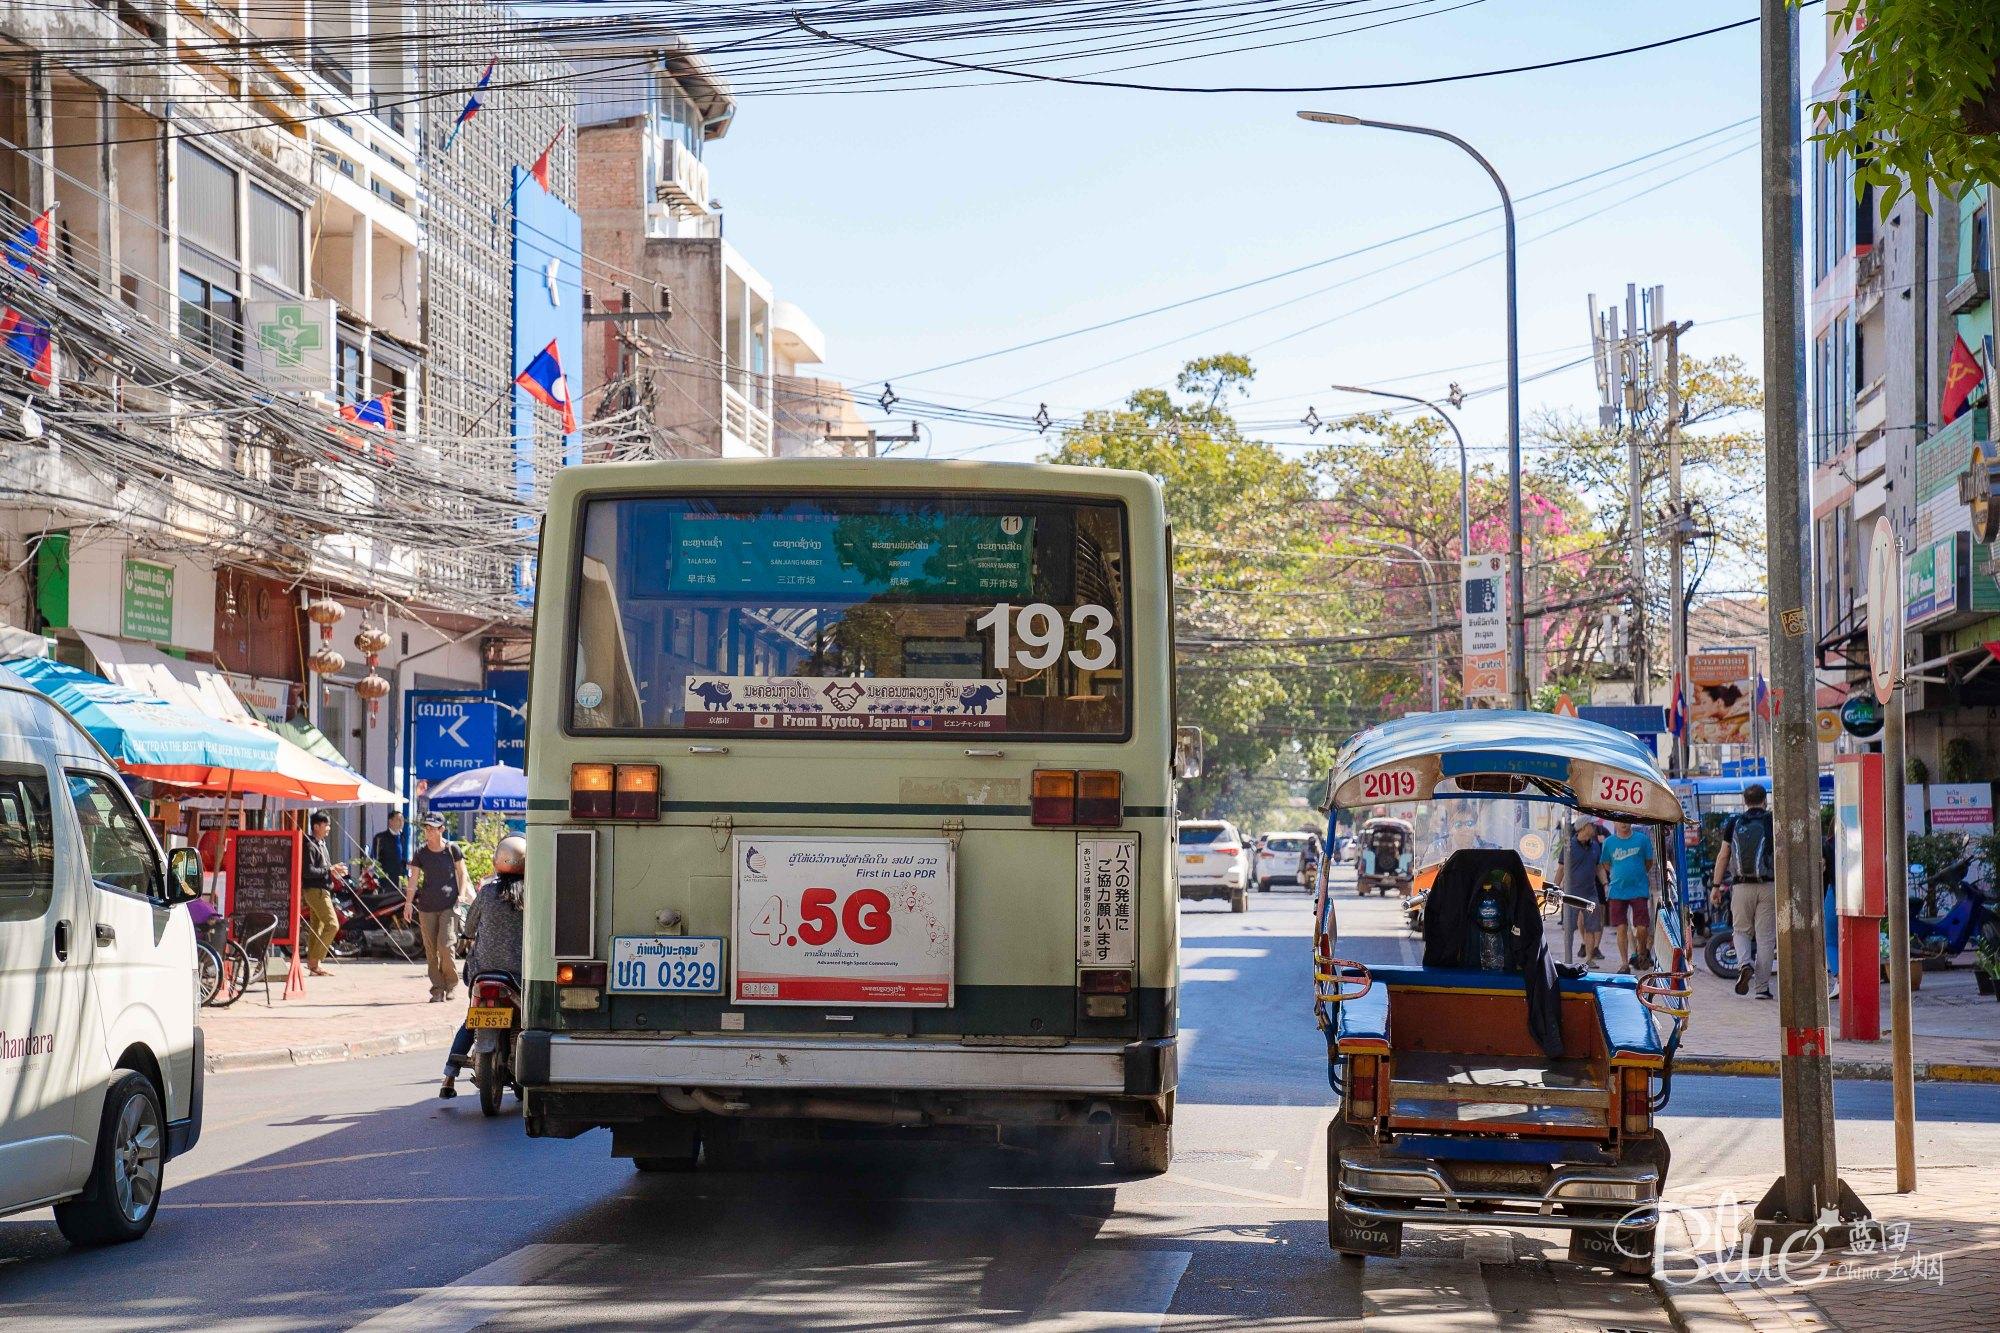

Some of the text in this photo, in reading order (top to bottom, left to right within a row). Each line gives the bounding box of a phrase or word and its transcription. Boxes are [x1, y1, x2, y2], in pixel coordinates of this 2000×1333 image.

[1003, 517, 1020, 531] 11
[688, 574, 716, 584] 早市场
[777, 576, 816, 585] 三江市场
[890, 577, 909, 587] 机场
[979, 578, 1019, 589] 西开市场
[976, 602, 1117, 671] 193
[1477, 660, 1502, 669] unitel
[782, 714, 908, 731] From Kyoto, Japan
[943, 720, 991, 728] ビエンチャン首都
[1364, 770, 1416, 798] 2019
[1600, 775, 1644, 805] 356
[492, 798, 507, 808] ST
[917, 857, 938, 865] ລາວ
[1083, 848, 1091, 884] あいさつは
[856, 868, 936, 878] First in Lao PDR
[1115, 844, 1131, 932] バスの発進に
[749, 887, 893, 946] 4.5G
[1096, 858, 1113, 961] ご協力願います
[658, 961, 716, 988] 0329
[0, 1027, 54, 1060] handara
[1344, 1228, 1389, 1244] OYOTA
